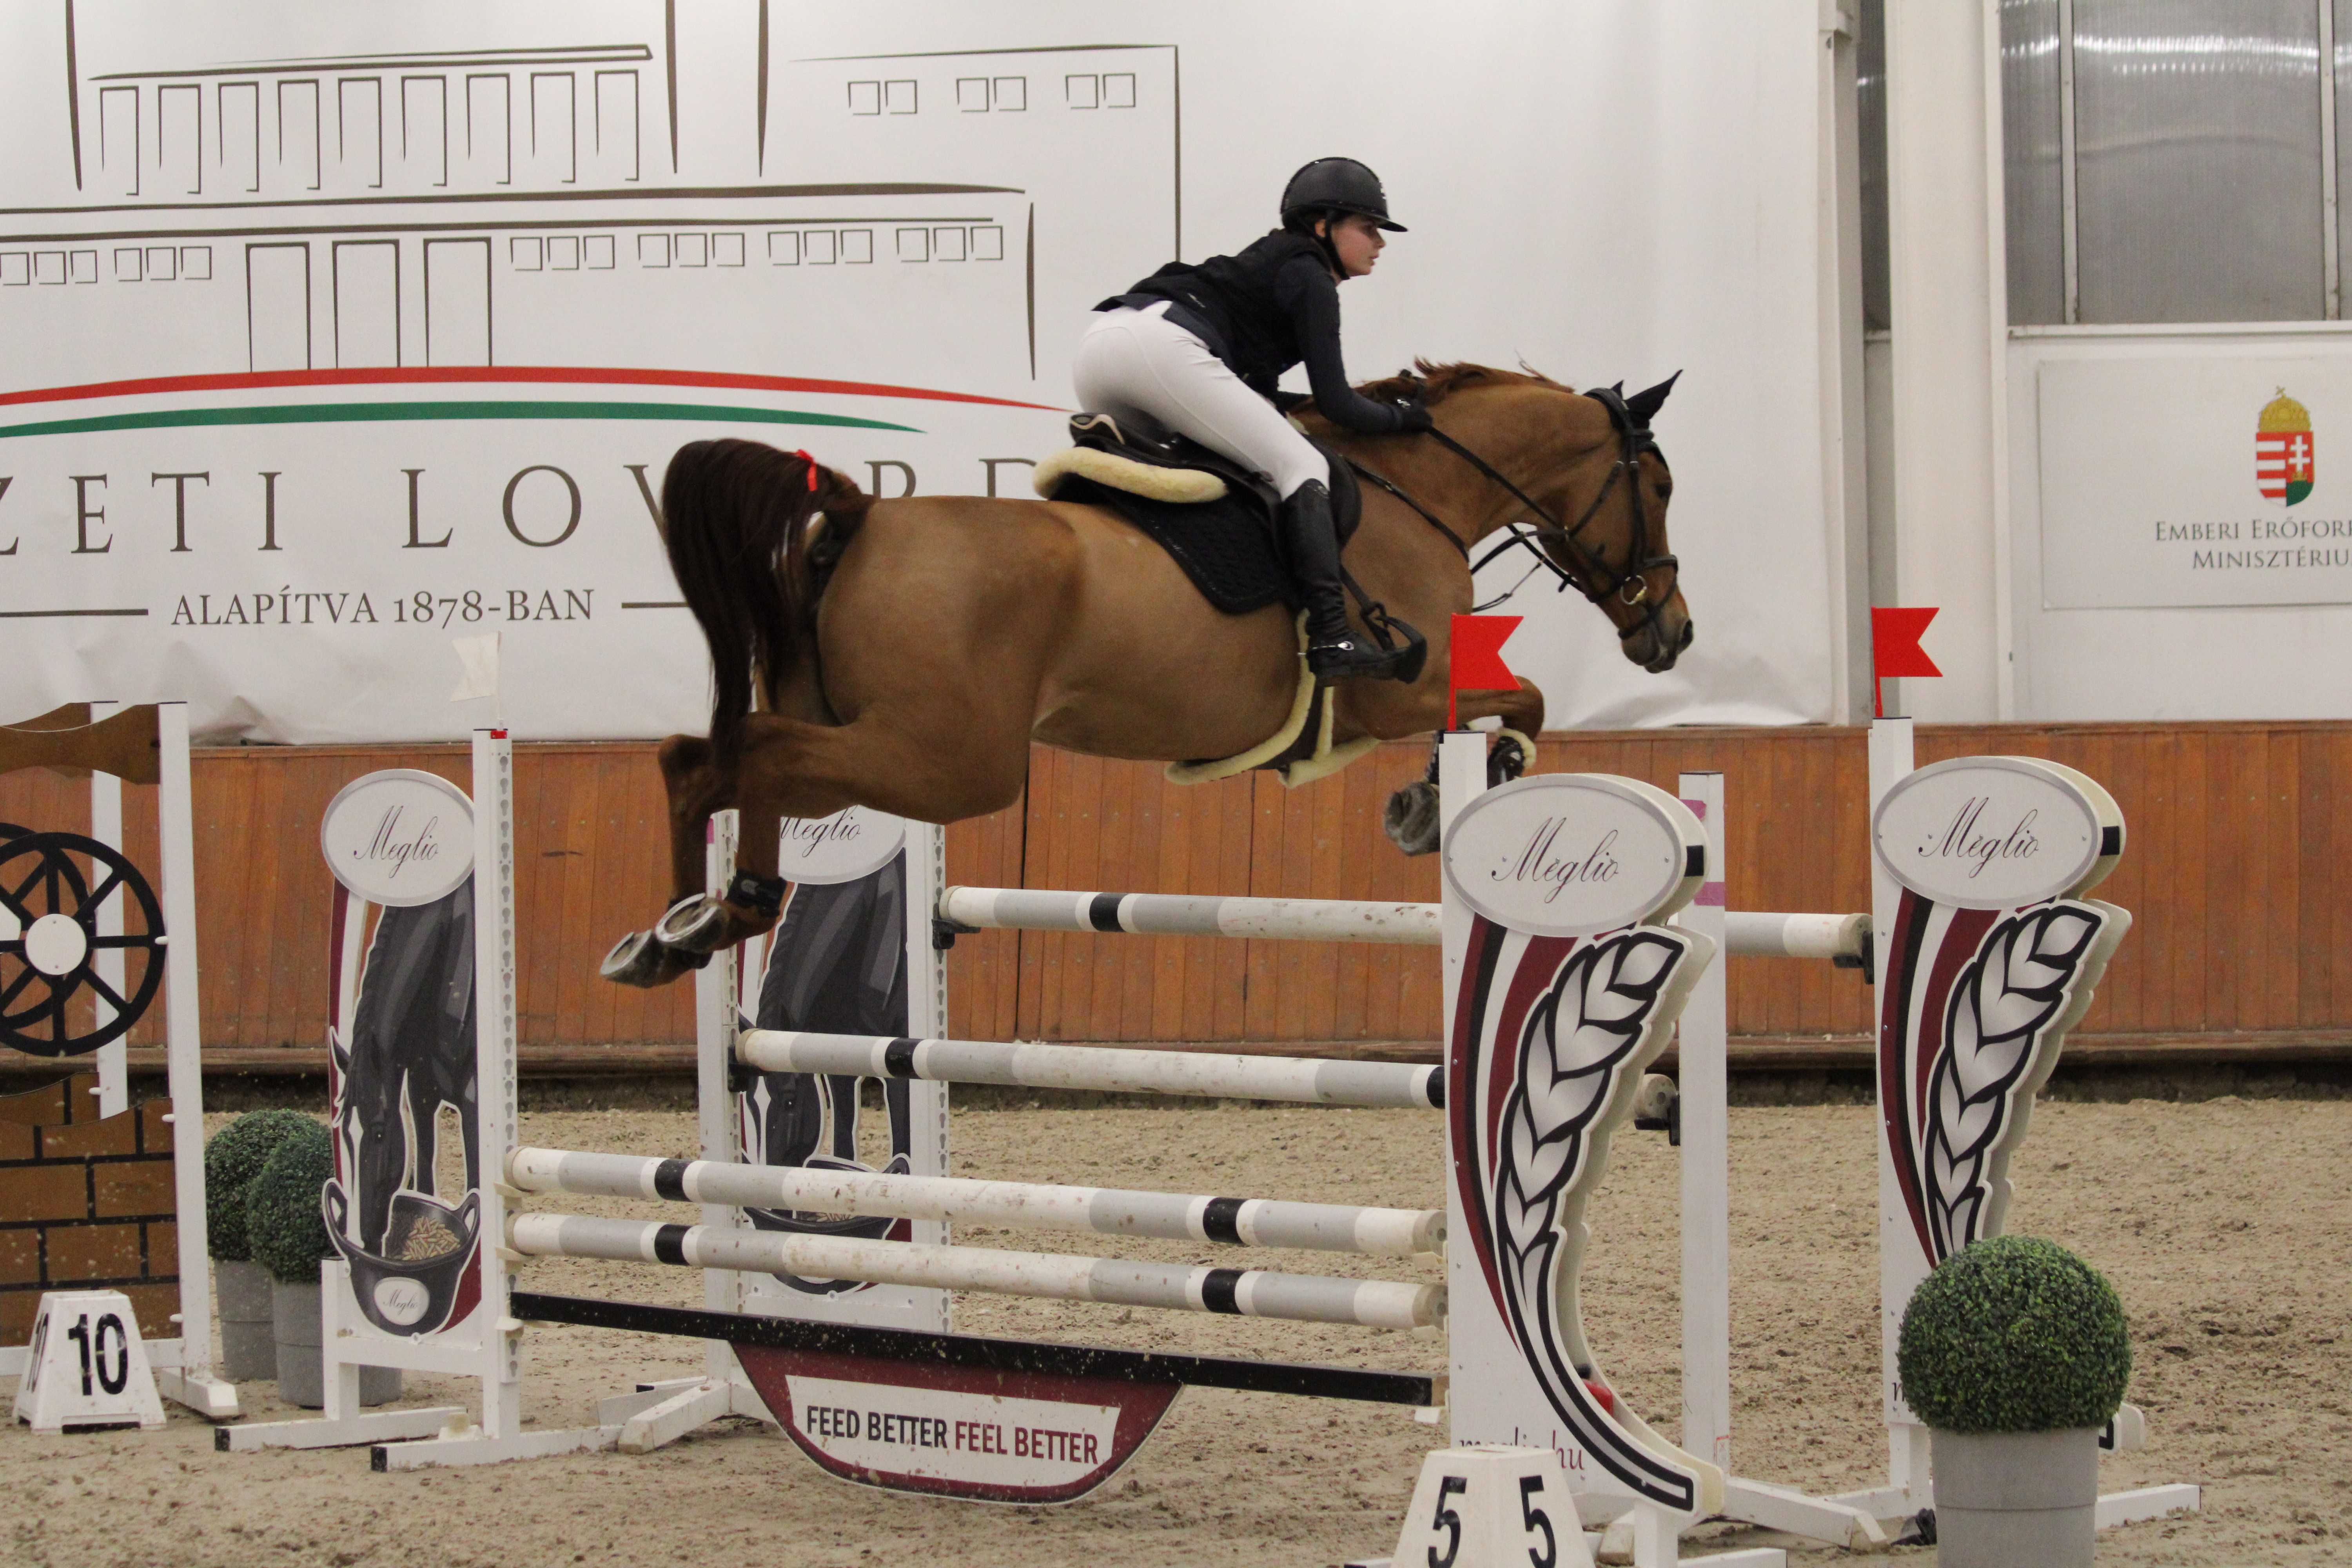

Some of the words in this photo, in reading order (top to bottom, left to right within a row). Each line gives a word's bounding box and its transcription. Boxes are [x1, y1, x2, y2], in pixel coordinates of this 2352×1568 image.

[2156, 521, 2239, 541] EMBERI
[2252, 517, 2352, 539] ERŐFOR
[2193, 546, 2352, 569] MINISZTÉRIU
[171, 585, 379, 625] ALAPÍTVA
[394, 589, 594, 630] 1878-BAN
[354, 805, 438, 878] Meglio
[1491, 817, 1619, 904] Meglio
[1918, 797, 2039, 878] Meglio
[383, 1289, 417, 1315] Meglio
[68, 1313, 128, 1396] 10
[808, 1405, 860, 1439] FEED
[868, 1412, 947, 1448] BETTER
[956, 1421, 1008, 1455] FEEL
[1015, 1426, 1098, 1465] BETTER
[1428, 1475, 1467, 1568] 5
[1519, 1475, 1556, 1568] 5
